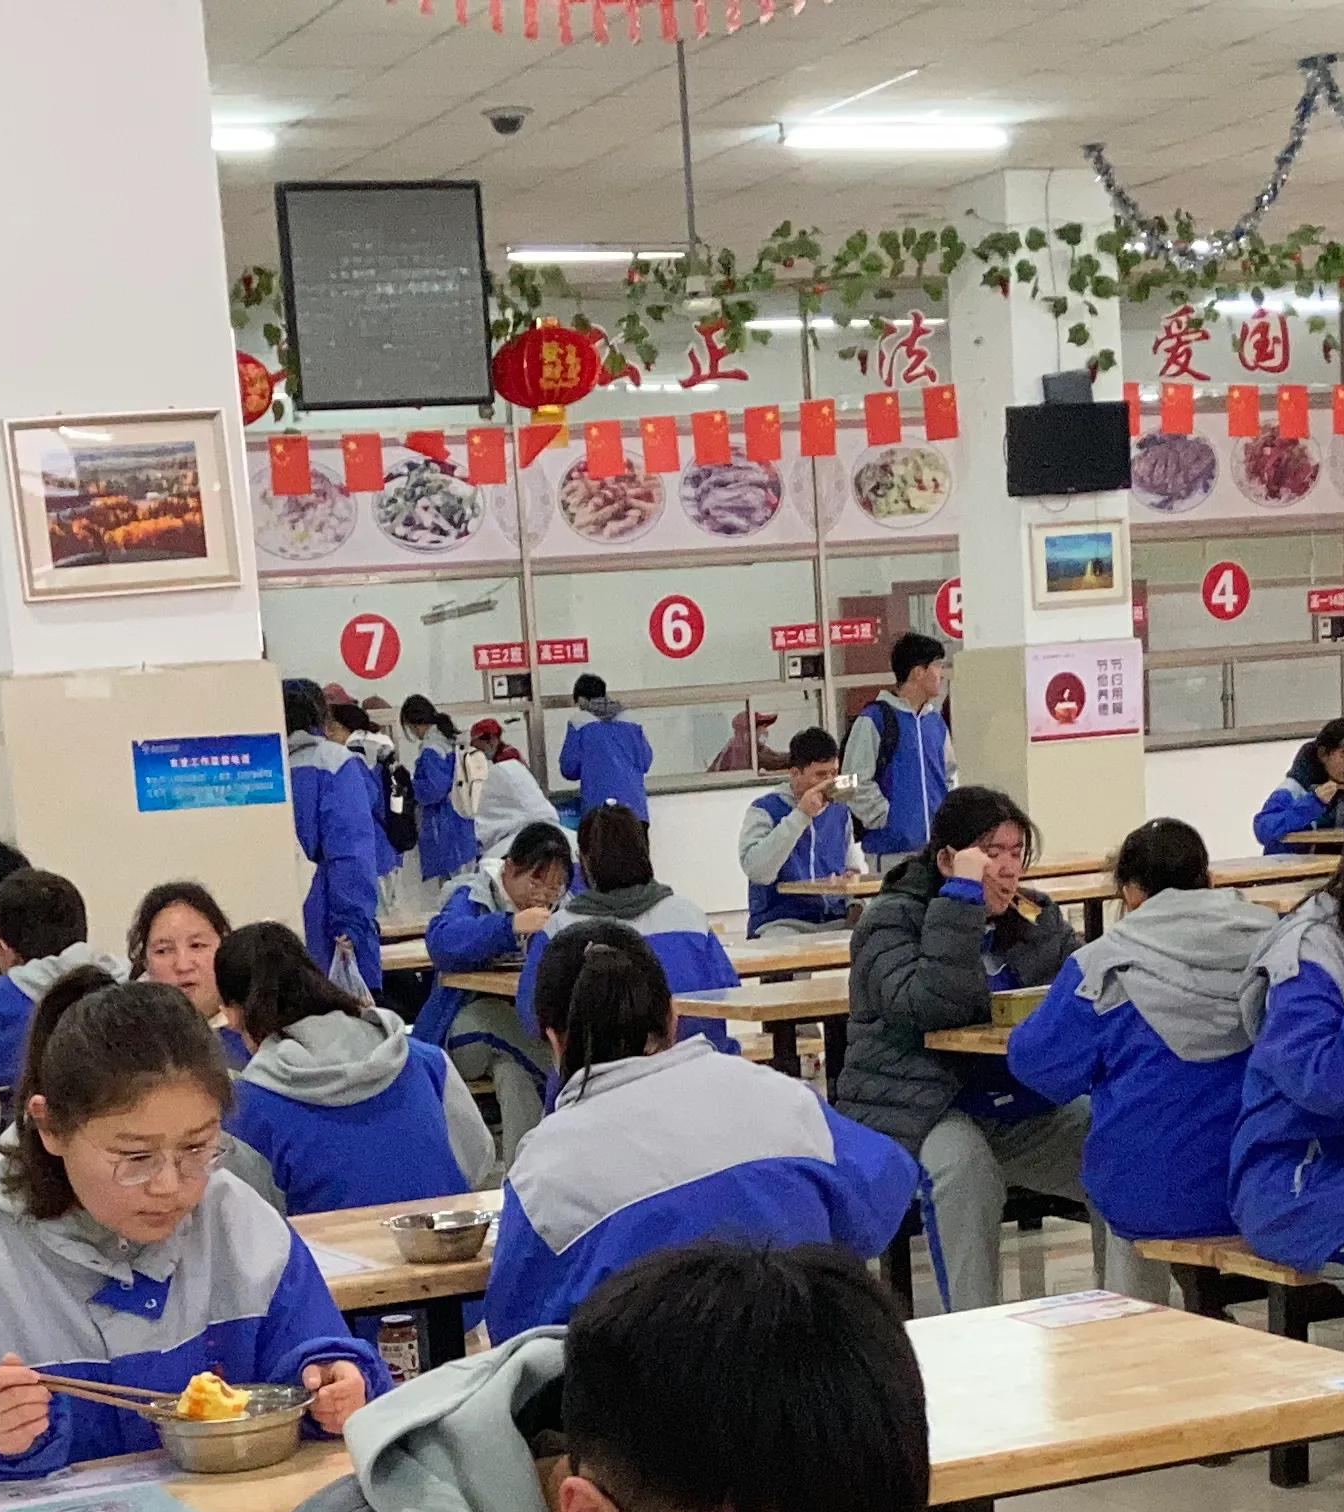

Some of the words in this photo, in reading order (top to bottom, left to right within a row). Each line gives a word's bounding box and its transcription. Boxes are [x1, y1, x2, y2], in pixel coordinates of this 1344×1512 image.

[1152, 303, 1290, 381] 爱国
[1210, 569, 1239, 612] 4
[356, 622, 386, 672] 7
[661, 603, 693, 650] 6
[477, 646, 524, 666] 高三2班
[540, 640, 585, 662] 高三1班
